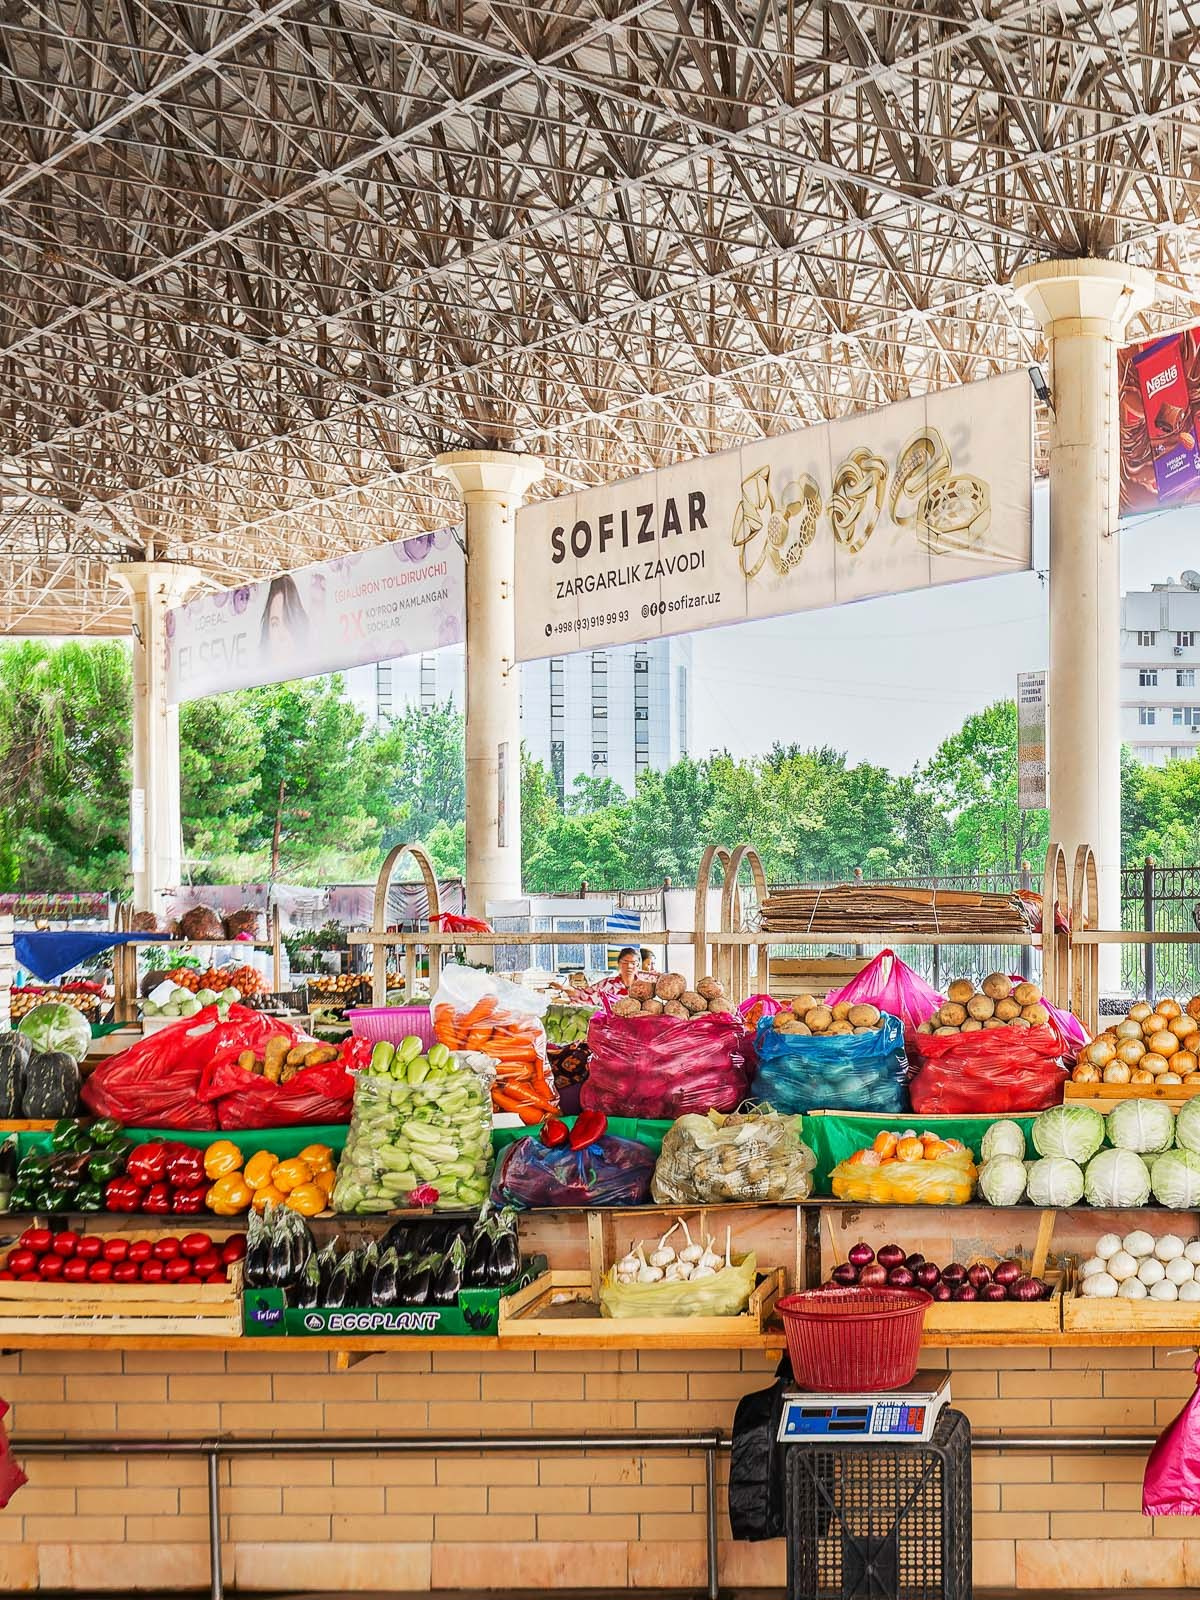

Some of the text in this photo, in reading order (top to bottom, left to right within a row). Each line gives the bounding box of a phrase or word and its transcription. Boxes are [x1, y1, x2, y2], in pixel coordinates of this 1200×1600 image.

[551, 491, 709, 564] SOFIZAR
[556, 549, 705, 599] ZARGARLIK ZAVODI
[398, 588, 449, 611] NAMLANGAN
[554, 592, 721, 634] +998 (93) 919 99 93 sofizar.uz
[340, 608, 367, 642] 2X
[328, 1311, 440, 1331] EGGPLANT
